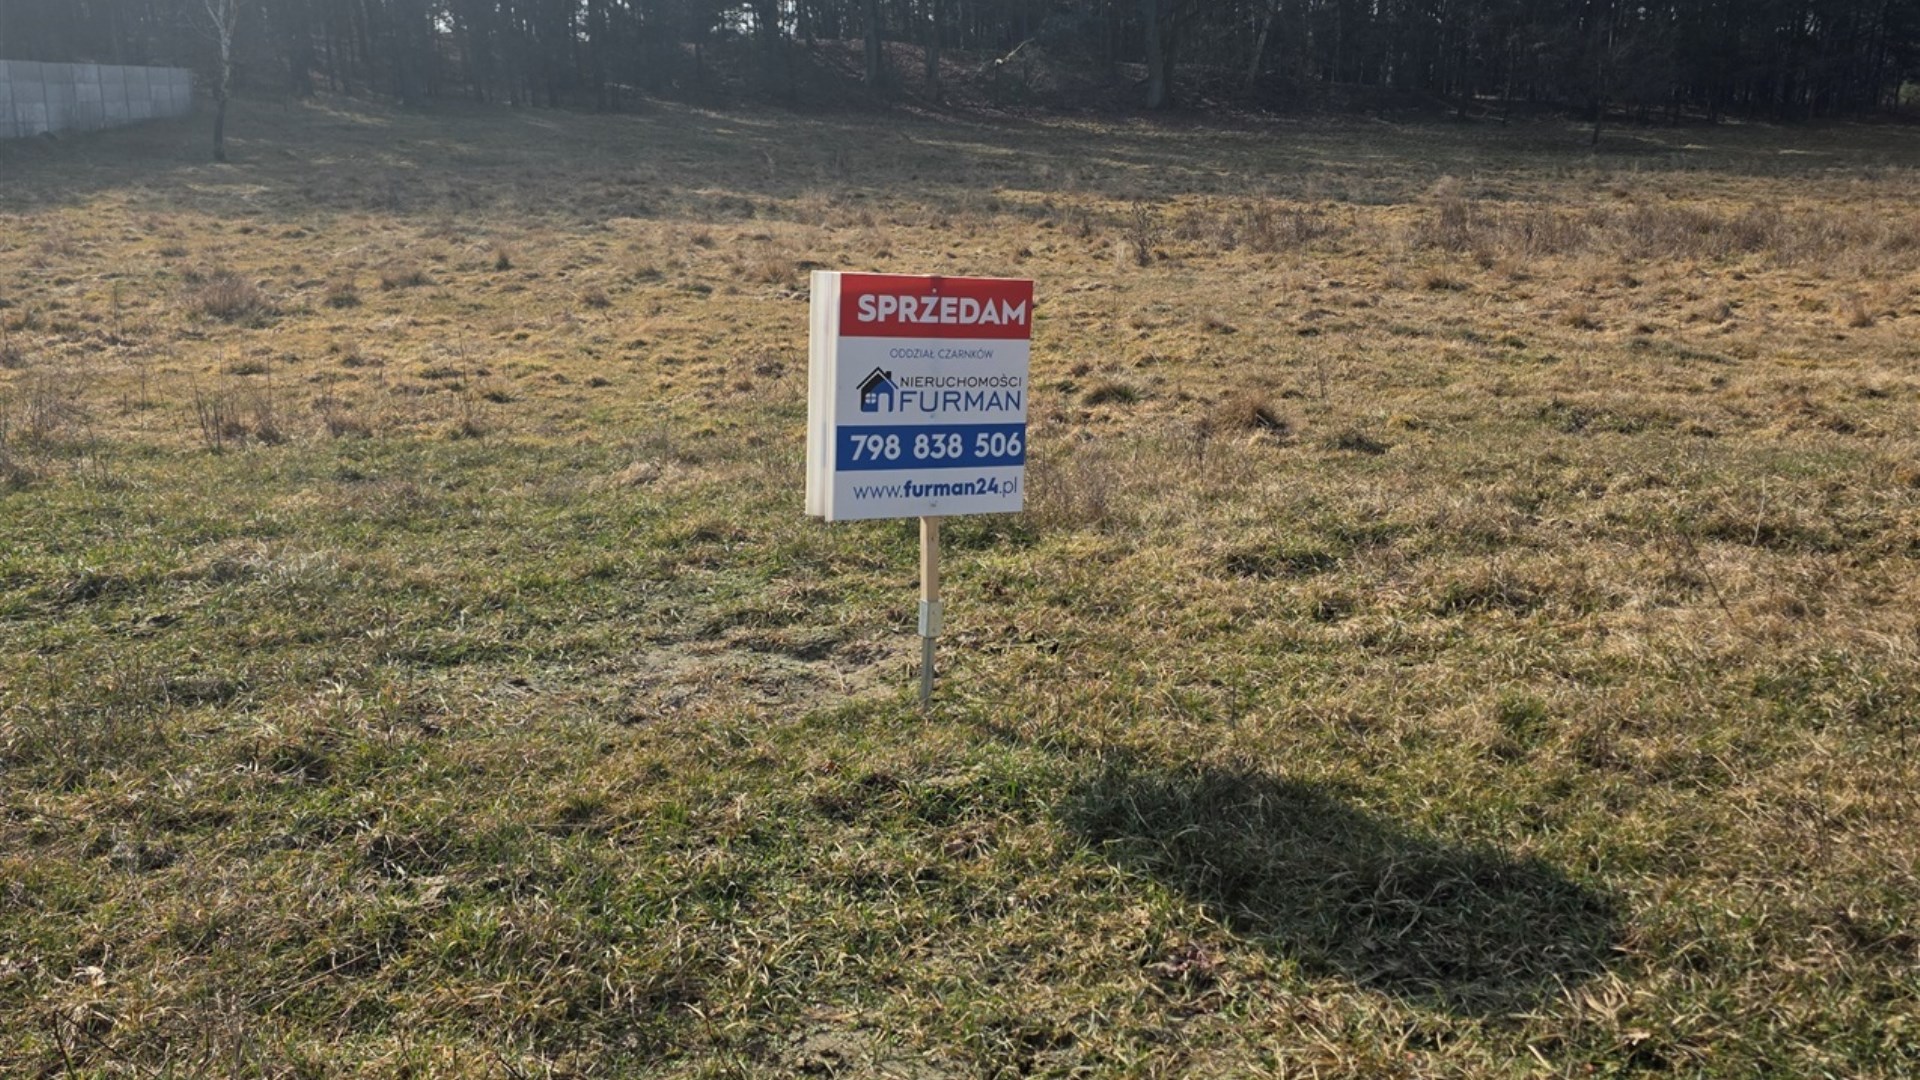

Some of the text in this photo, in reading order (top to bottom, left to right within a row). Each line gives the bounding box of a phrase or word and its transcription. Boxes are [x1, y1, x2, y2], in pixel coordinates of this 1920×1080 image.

[857, 294, 1026, 325] SPRZEDAM
[889, 348, 994, 360] ODDZIAŁ CZARNKÓW
[900, 374, 1022, 388] NIERUCHOMOŚCI
[899, 391, 1021, 412] FURMAN
[850, 432, 1022, 461] 798 838 506
[853, 477, 1018, 499] www.furman24.pl
